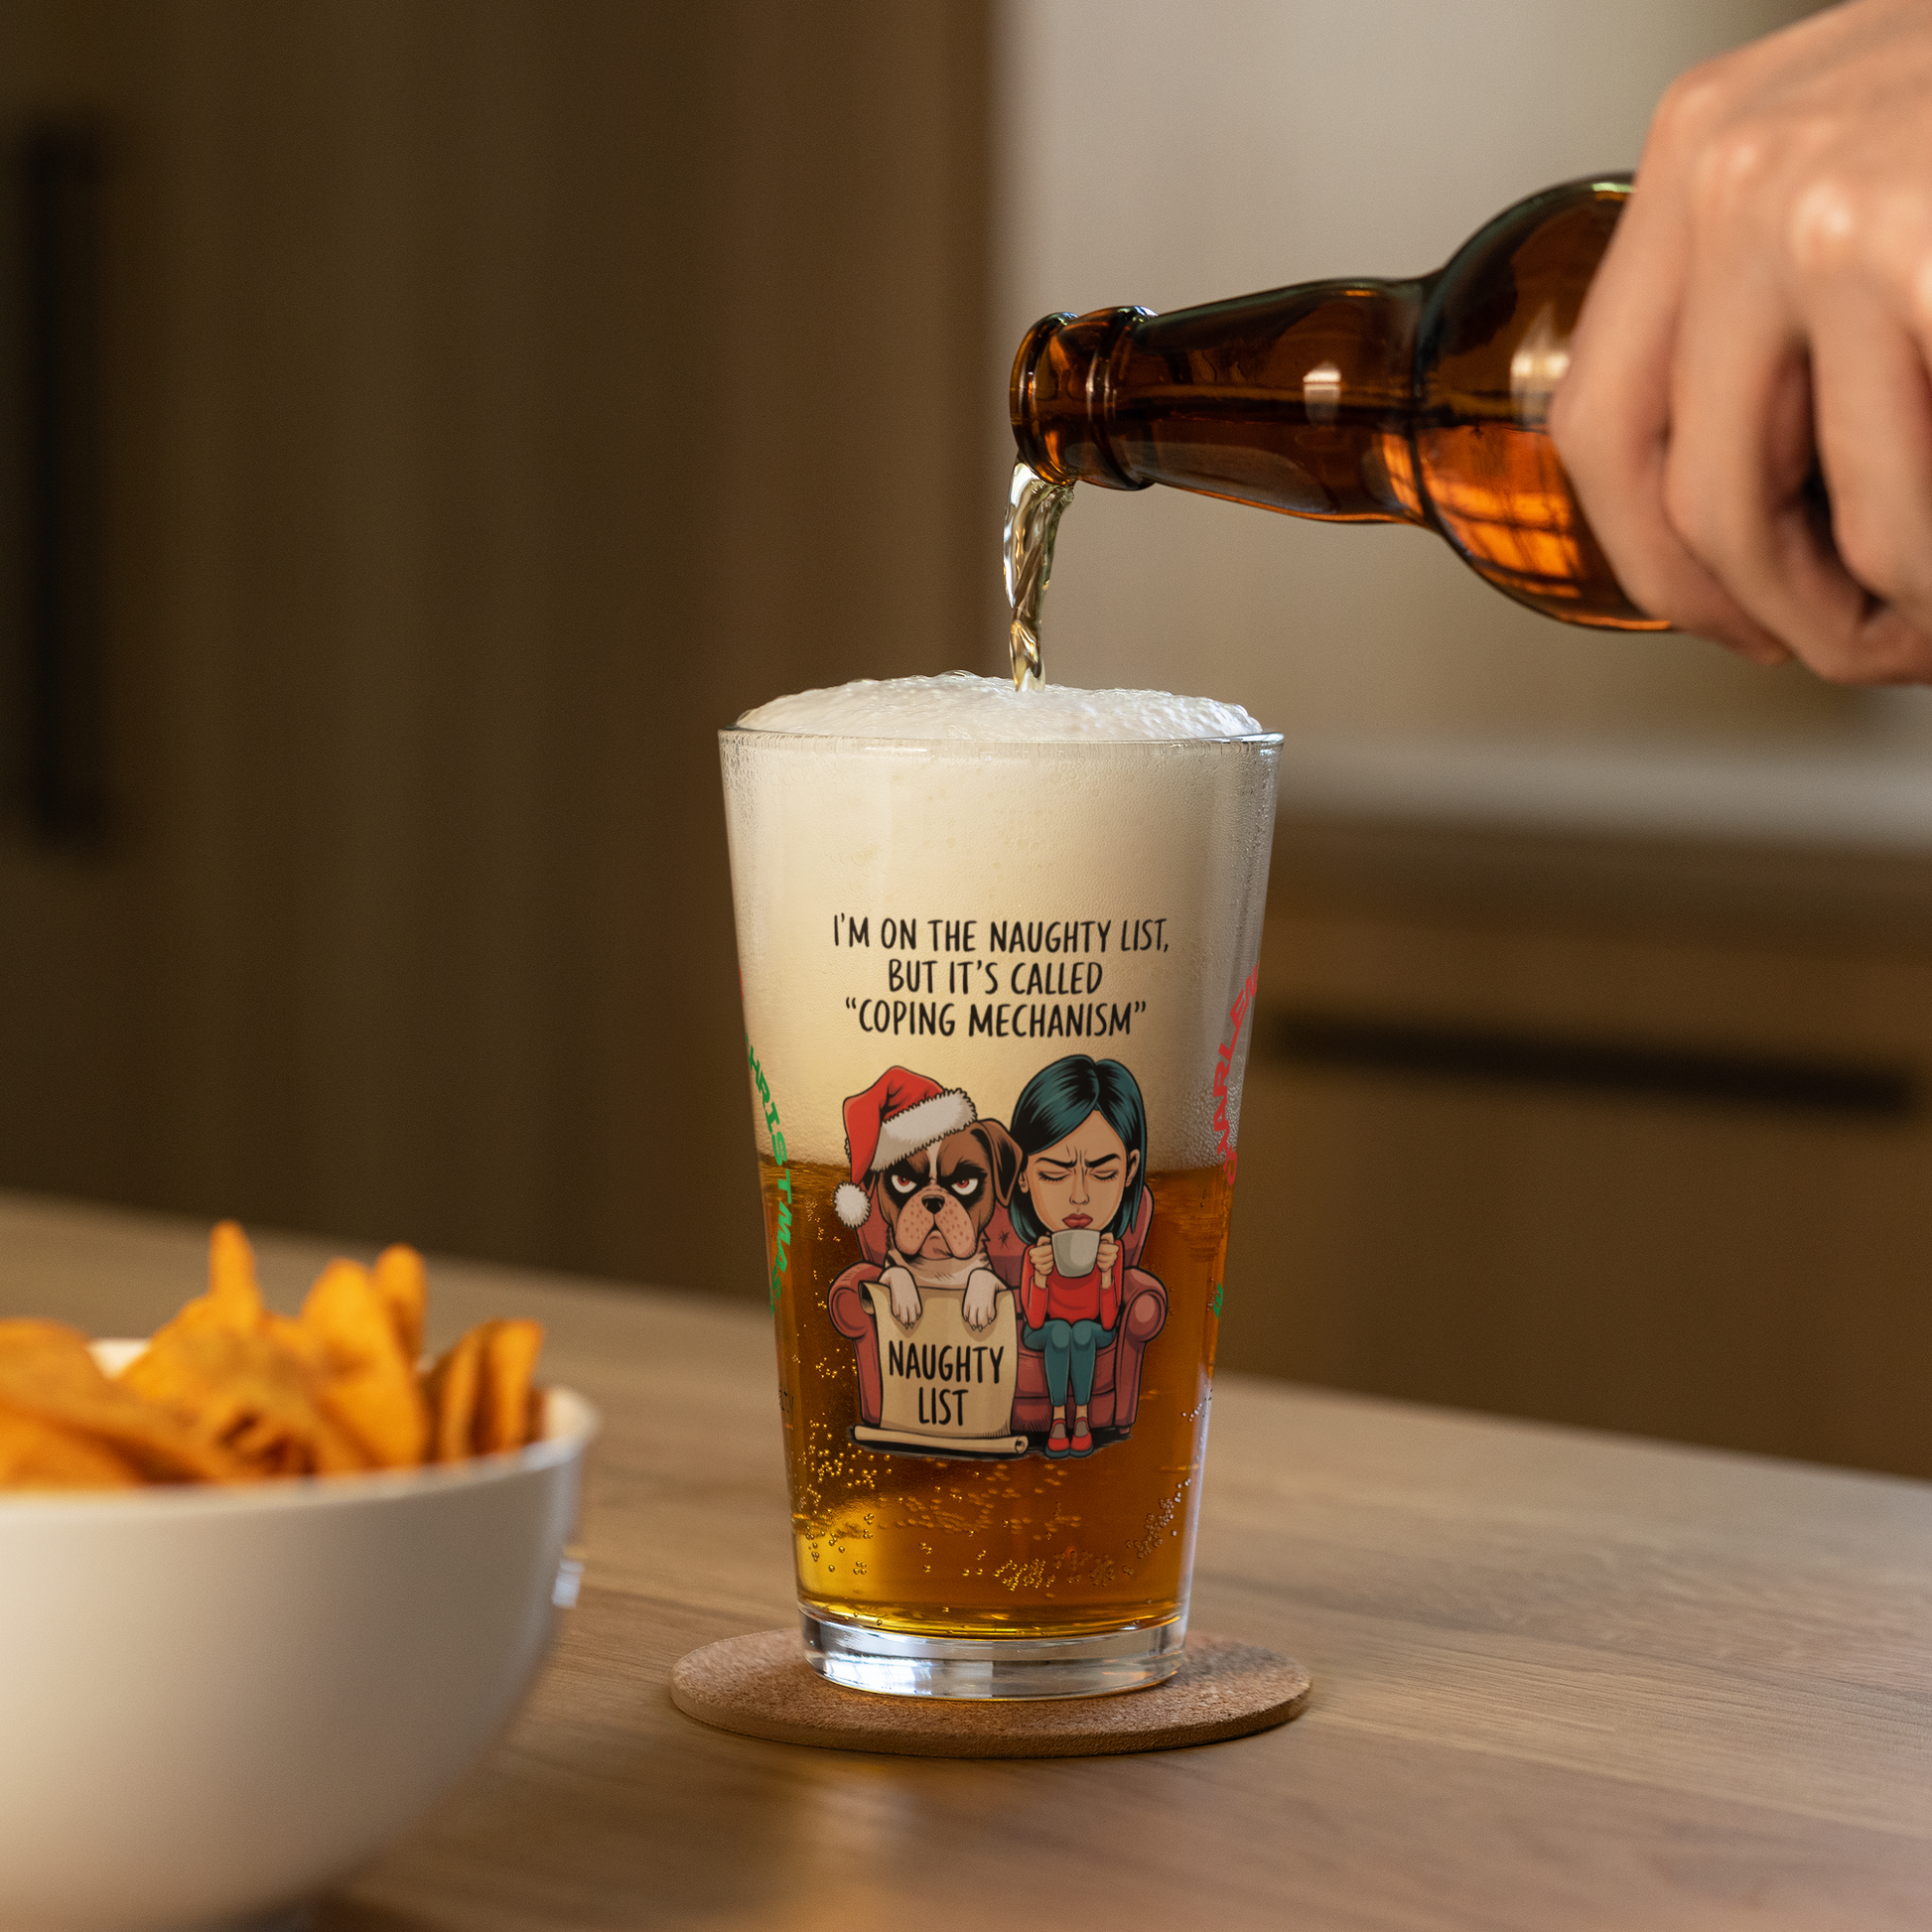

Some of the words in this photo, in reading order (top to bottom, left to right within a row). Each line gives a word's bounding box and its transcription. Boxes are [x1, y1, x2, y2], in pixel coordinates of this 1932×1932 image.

[834, 912, 870, 947] I’M
[881, 917, 916, 950] ON
[927, 919, 977, 952] THE
[990, 919, 1112, 953] NAUGHTY
[1120, 918, 1170, 953] LIST,
[889, 958, 937, 993] BUT
[949, 959, 999, 995] IT’S
[1011, 962, 1103, 995] CALLED
[846, 996, 955, 1036] “COPING
[969, 1000, 1147, 1037] MECHANISM”
[1213, 960, 1260, 1185] CHARLEN
[747, 1034, 791, 1302] HRISTMAS
[889, 1340, 1004, 1384] NAUGHTY
[918, 1386, 969, 1427] LIST
